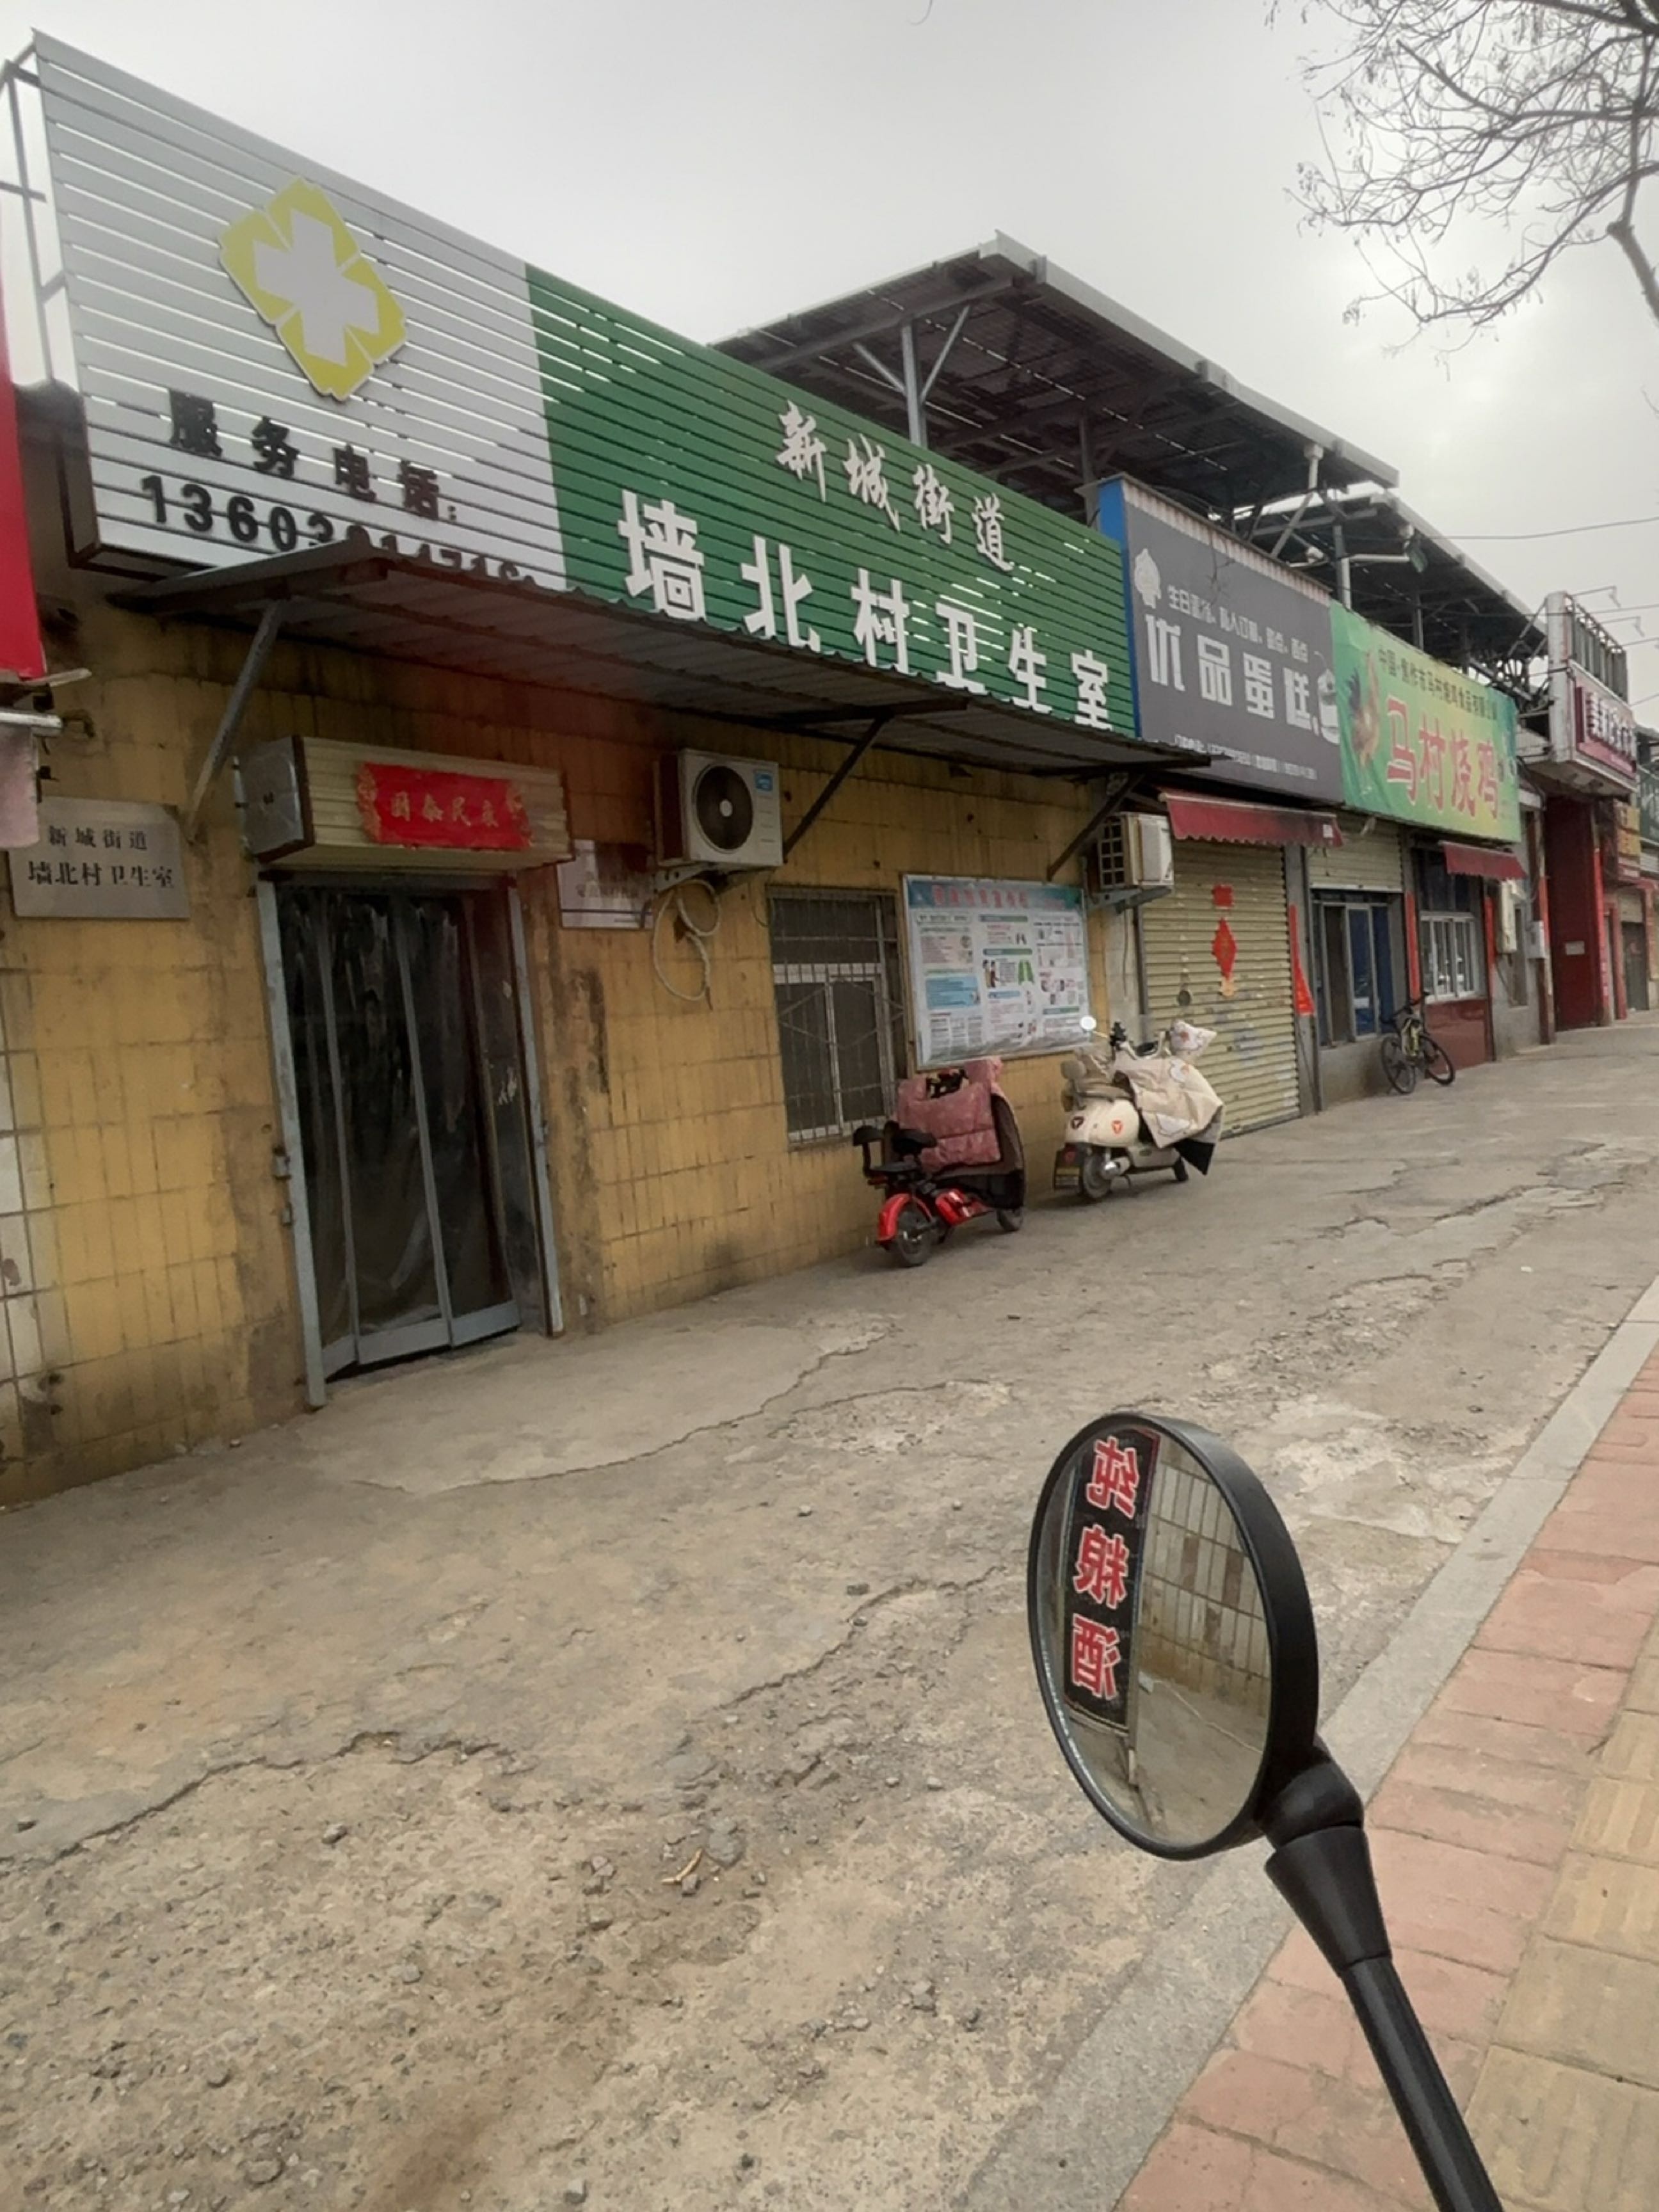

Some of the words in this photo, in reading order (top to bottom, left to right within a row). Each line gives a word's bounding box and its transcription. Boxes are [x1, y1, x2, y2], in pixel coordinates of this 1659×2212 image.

[775, 399, 1013, 572] 新城街道
[617, 488, 1113, 730] 墙北村卫生室
[1386, 695, 1500, 820] 马村烧鸡
[28, 860, 175, 888] 墙北村卫生室
[49, 824, 148, 850] 新城街道
